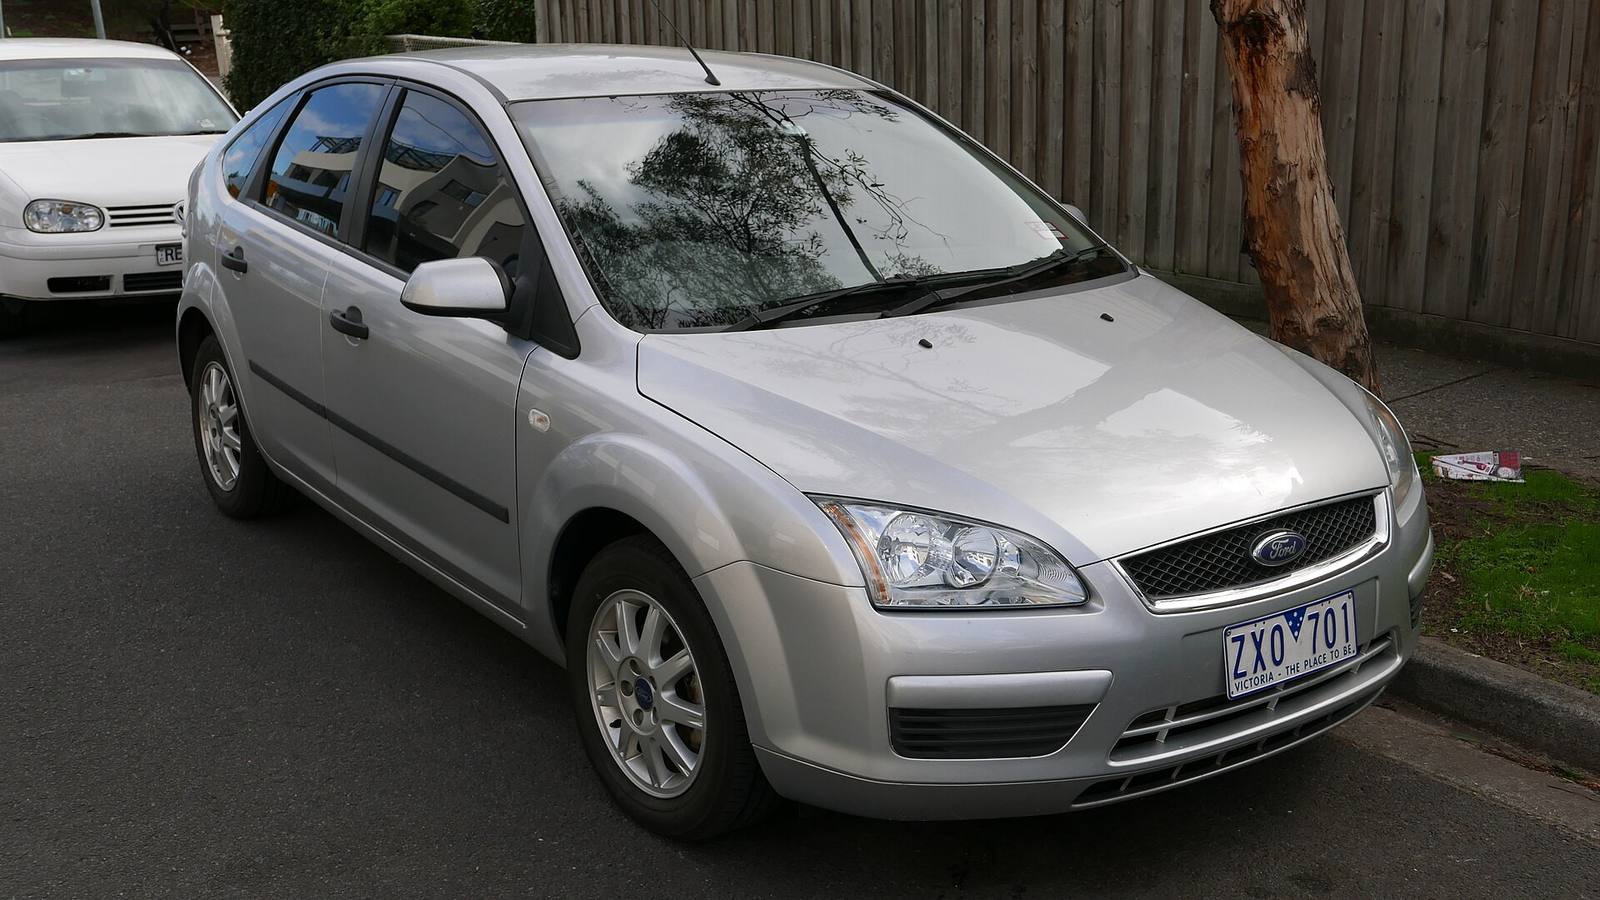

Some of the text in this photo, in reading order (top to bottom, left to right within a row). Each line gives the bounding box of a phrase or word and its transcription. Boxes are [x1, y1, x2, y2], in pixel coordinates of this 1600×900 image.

[1270, 539, 1296, 559] Ford
[1231, 602, 1349, 680] ZXO 701
[1234, 672, 1274, 692] VICTORIA
[1285, 663, 1300, 676] THE
[1304, 653, 1327, 669] PLACE
[1330, 649, 1340, 658] TO
[1343, 643, 1356, 654] BE.
